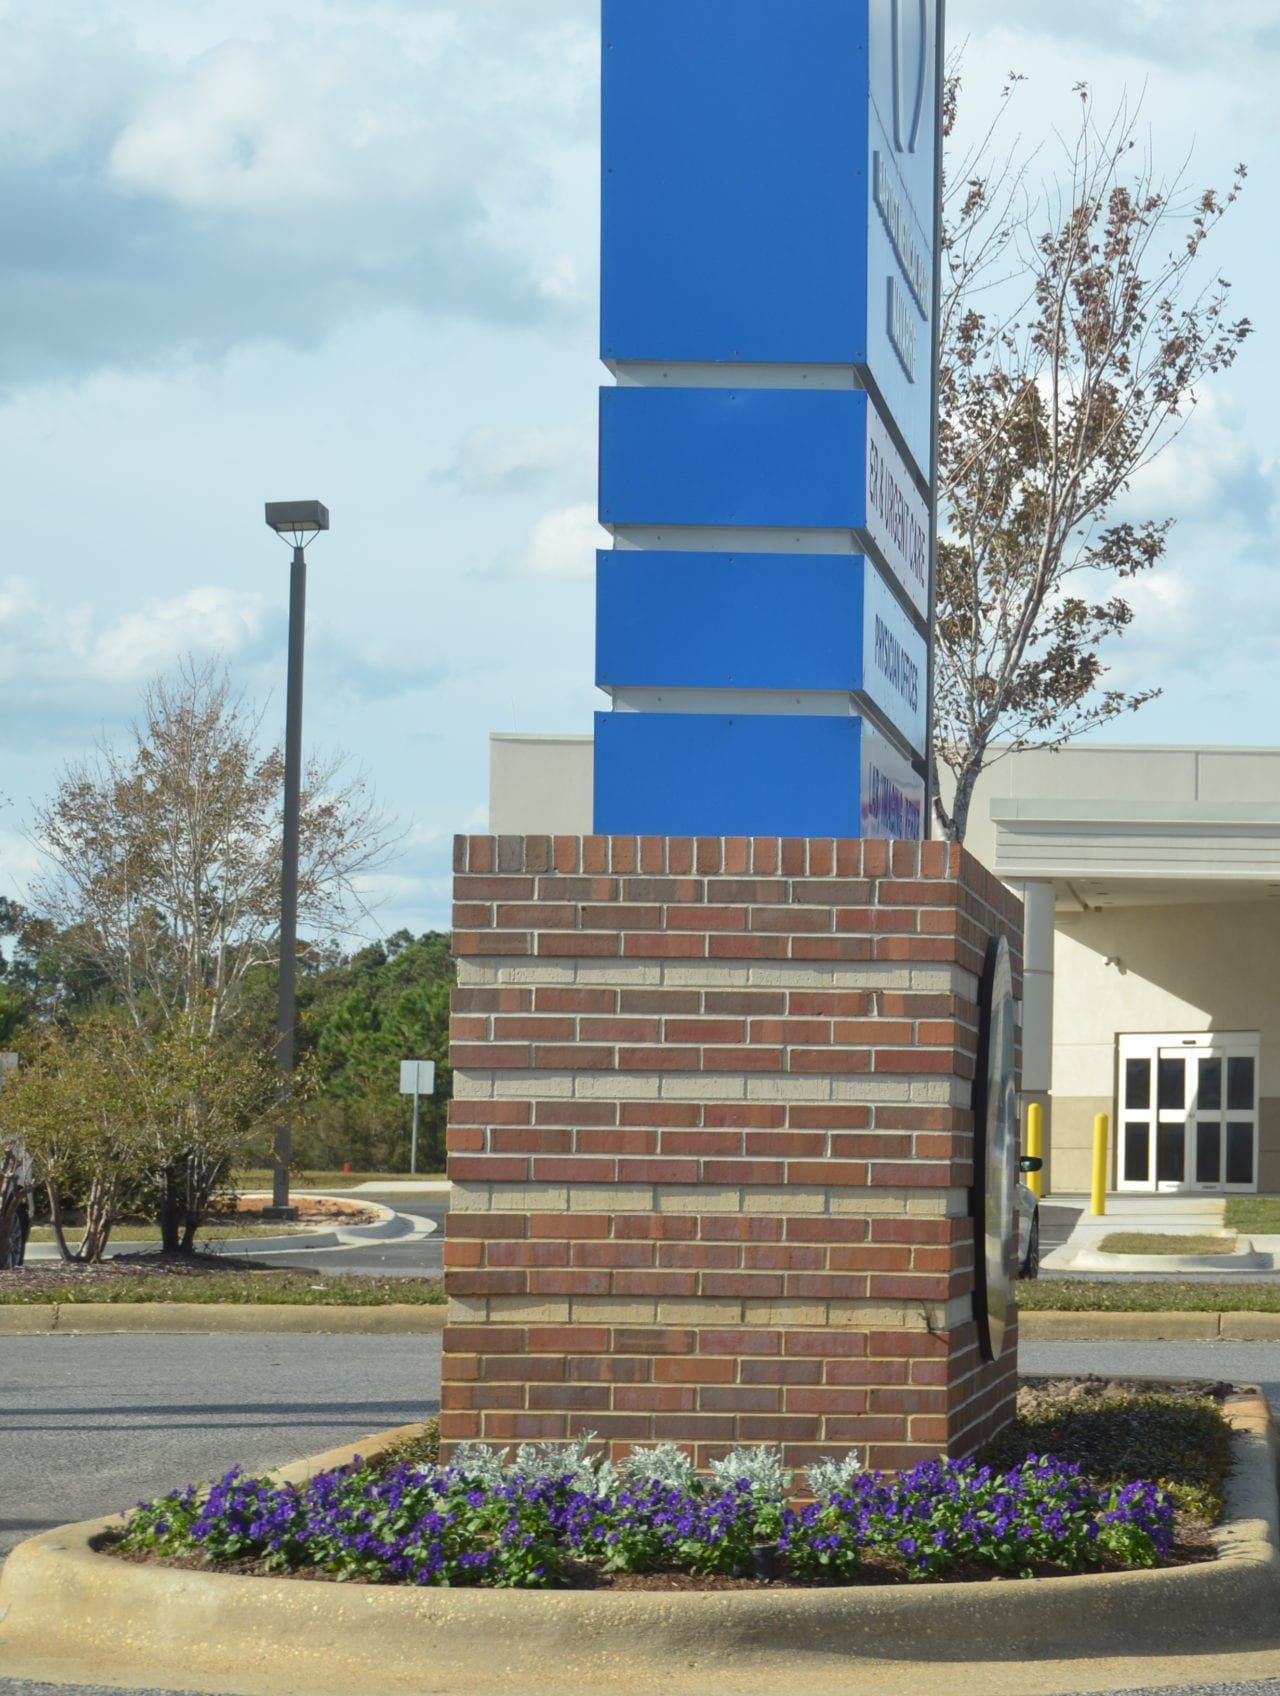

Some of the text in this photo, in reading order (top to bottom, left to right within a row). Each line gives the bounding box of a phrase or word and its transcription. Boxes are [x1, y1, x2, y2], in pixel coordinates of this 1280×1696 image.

[869, 438, 879, 511] ER
[884, 467, 909, 562] URGENT
[909, 512, 926, 588] CARE
